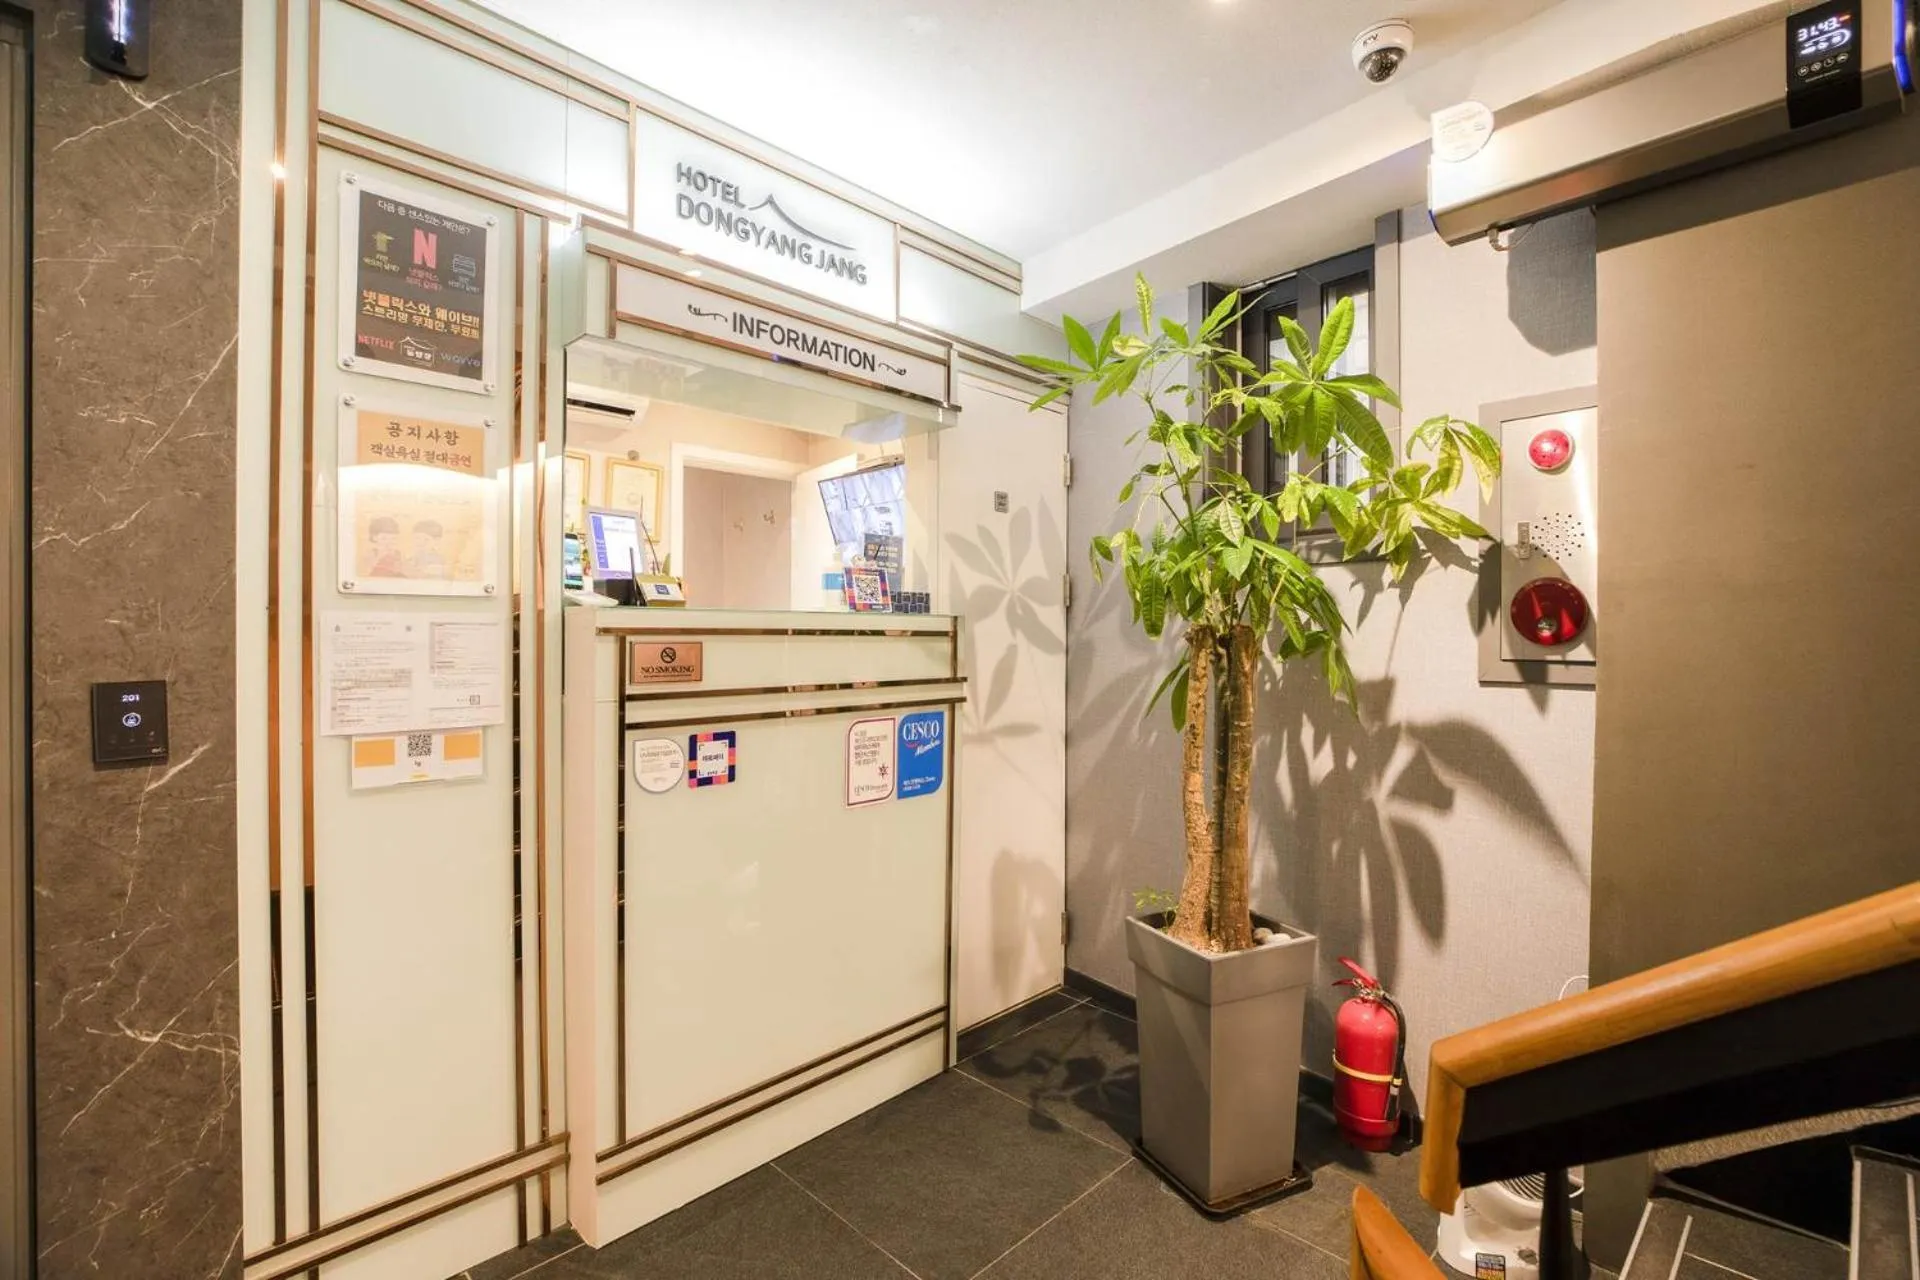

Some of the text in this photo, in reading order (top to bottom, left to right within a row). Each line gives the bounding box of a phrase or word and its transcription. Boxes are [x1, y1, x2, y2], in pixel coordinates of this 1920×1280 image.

[675, 162, 746, 209] HOTEL
[413, 228, 438, 269] N
[675, 192, 868, 286] DONGYANG JANG
[361, 304, 408, 324] 스트리밍
[362, 289, 431, 316] 넷플릭스와
[357, 334, 395, 350] NETFLIX
[732, 311, 876, 373] INFORMATION
[386, 421, 459, 446] 공지사항
[654, 665, 695, 674] SMOKING
[903, 721, 940, 741] CESCO
